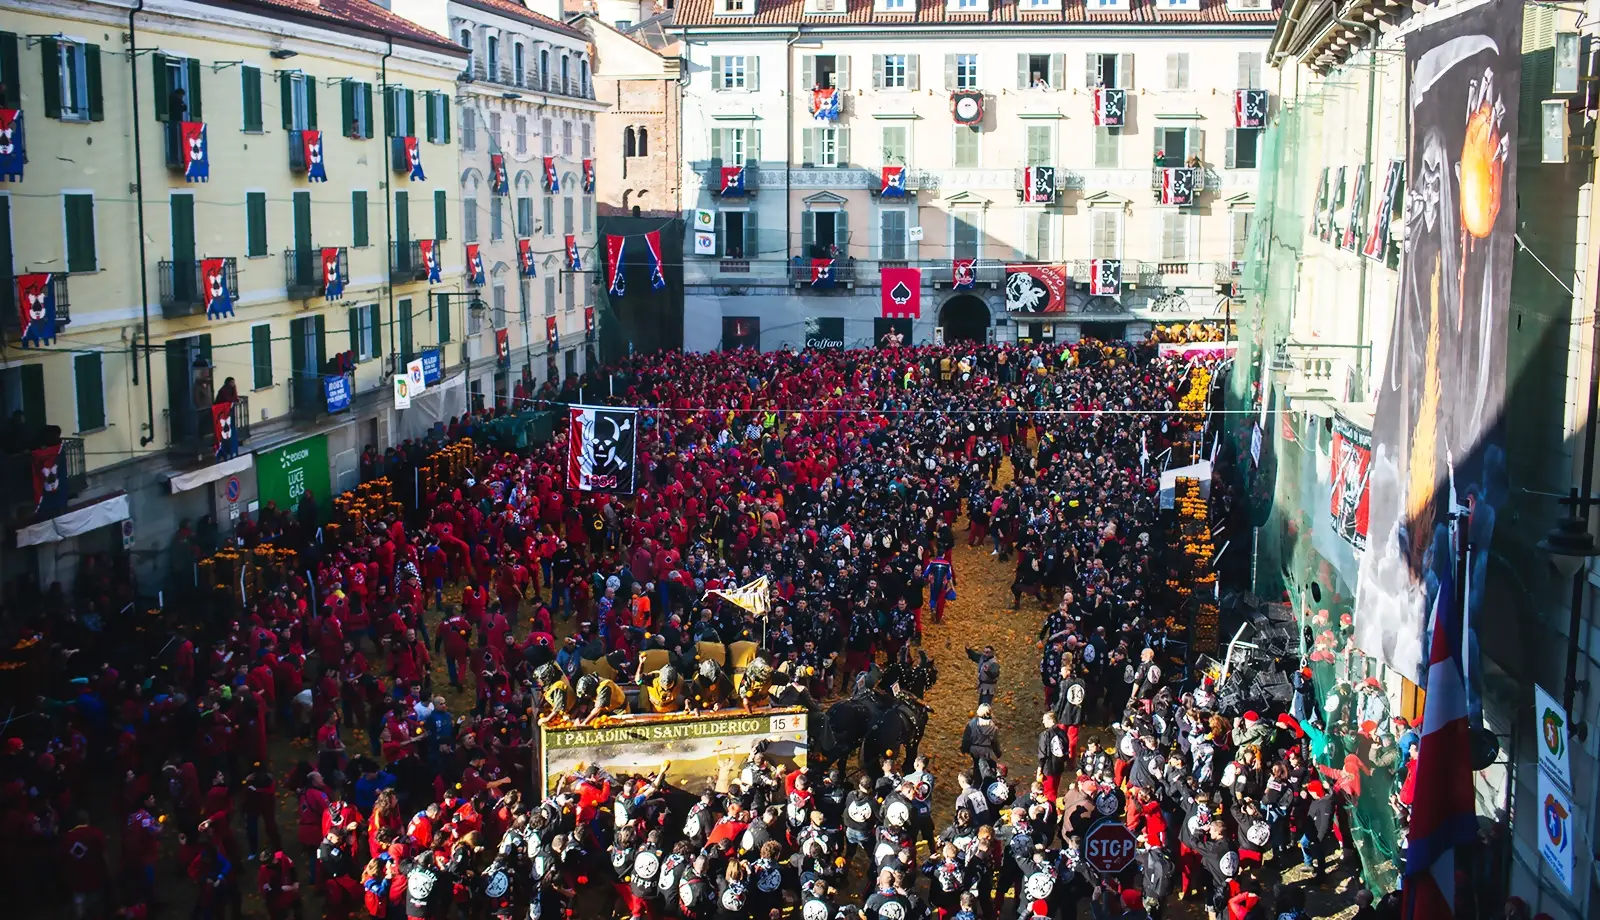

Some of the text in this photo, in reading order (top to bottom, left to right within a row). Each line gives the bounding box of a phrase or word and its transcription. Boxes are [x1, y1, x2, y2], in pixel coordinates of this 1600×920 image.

[1036, 266, 1064, 286] FONDO
[807, 338, 842, 349] Caffaro
[288, 470, 304, 486] LUCE
[289, 482, 305, 498] GAS
[772, 718, 786, 730] 15
[556, 734, 562, 745] I
[637, 730, 650, 739] DI
[653, 721, 760, 739] SANT'ULDERICO
[1089, 840, 1133, 857] STOP
